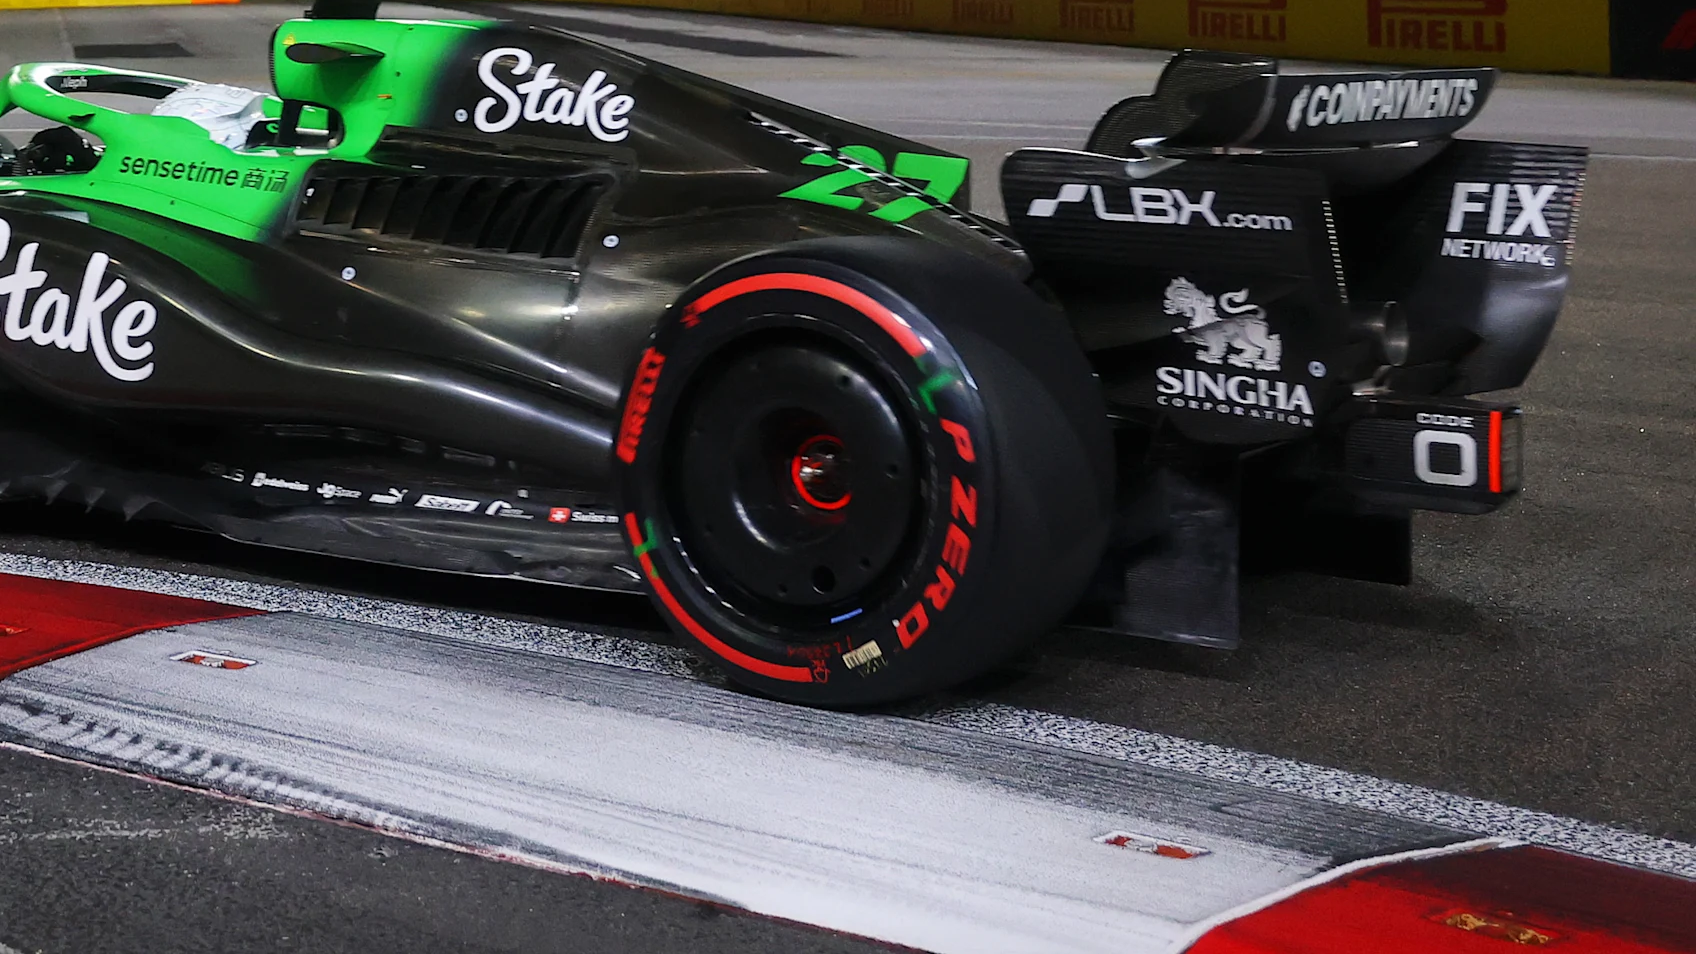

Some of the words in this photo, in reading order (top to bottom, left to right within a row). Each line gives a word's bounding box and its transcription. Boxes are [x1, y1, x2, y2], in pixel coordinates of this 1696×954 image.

[473, 47, 635, 142] Stake
[119, 155, 239, 187] sensetime
[240, 167, 291, 193] 商汤
[783, 145, 970, 223] 27
[1090, 184, 1293, 230] LBX.com
[1446, 182, 1558, 237] FIX
[1441, 238, 1553, 265] NETWORK
[1155, 366, 1315, 416] SINGHA
[1156, 396, 1314, 428] CORPORATION
[939, 418, 977, 463] P
[1416, 412, 1475, 428] CODE
[895, 474, 978, 650] ZERO
